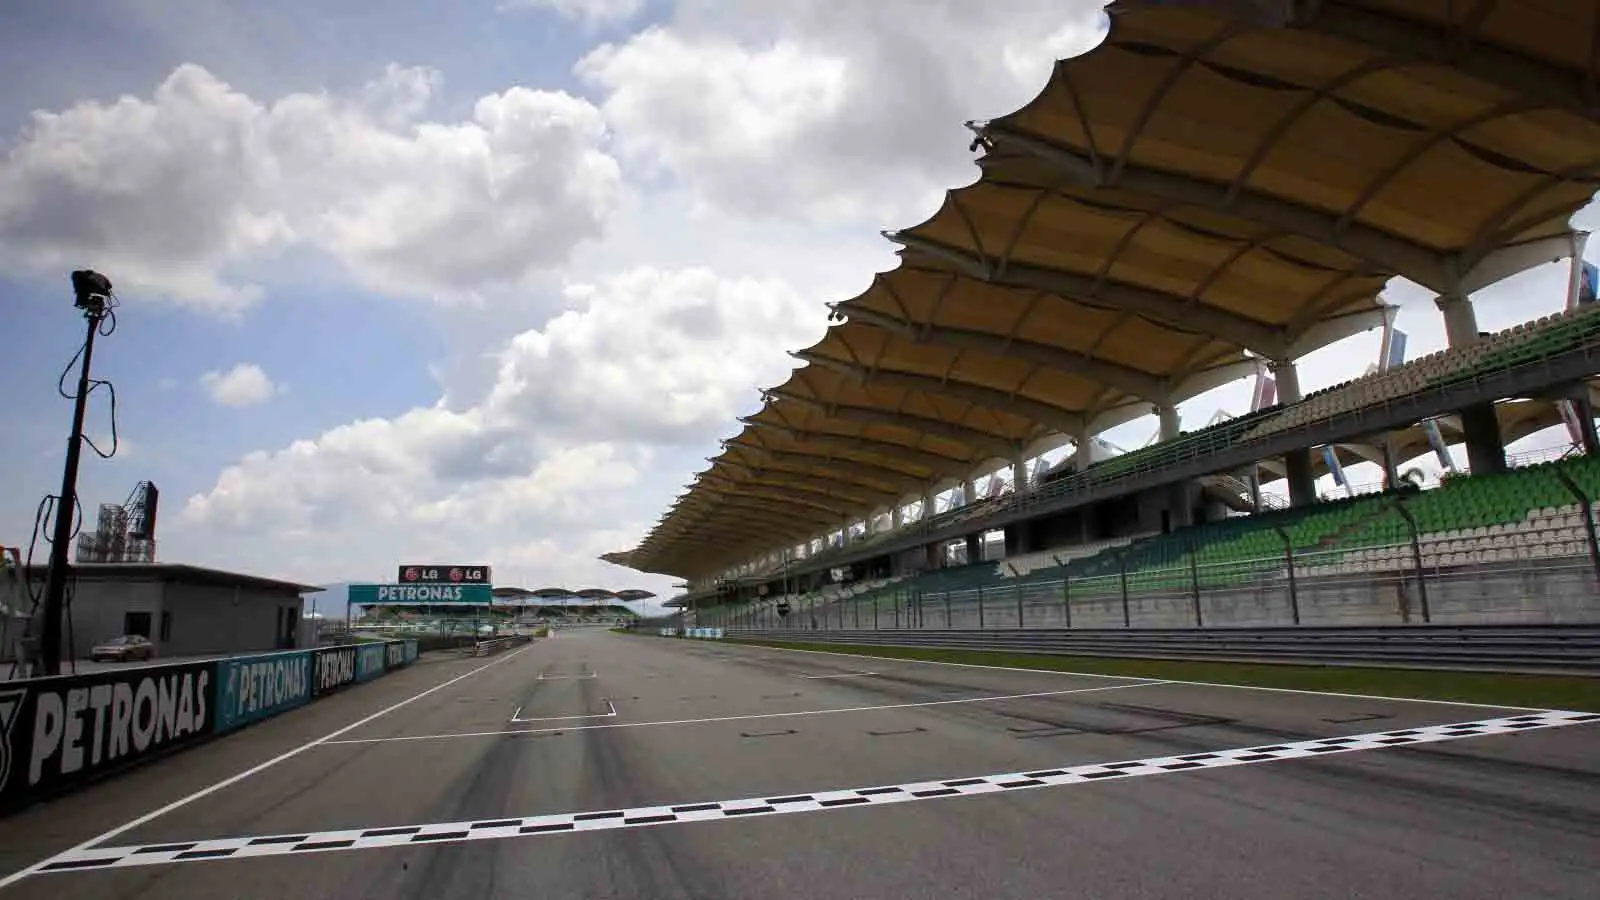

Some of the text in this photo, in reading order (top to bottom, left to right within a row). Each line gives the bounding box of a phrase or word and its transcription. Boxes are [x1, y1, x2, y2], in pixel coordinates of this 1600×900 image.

[422, 569, 438, 579] LG
[465, 569, 482, 579] LG
[378, 586, 462, 600] PETRONAS
[238, 656, 307, 715] PETRONAS
[28, 670, 209, 786] PETRONAS
